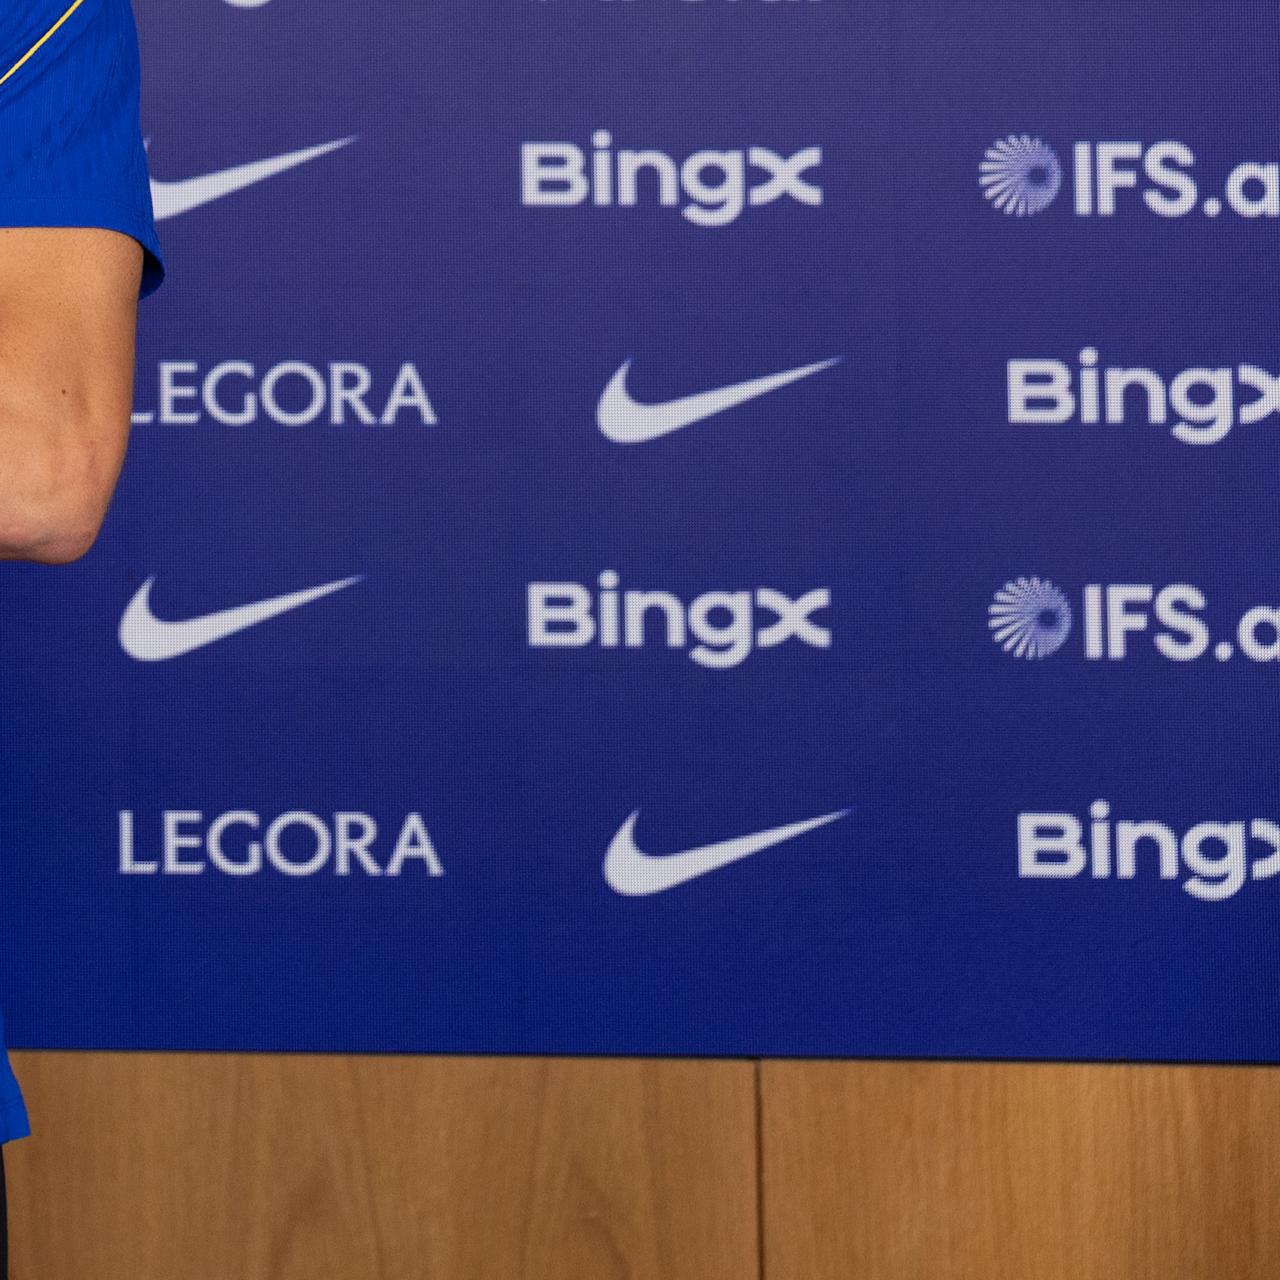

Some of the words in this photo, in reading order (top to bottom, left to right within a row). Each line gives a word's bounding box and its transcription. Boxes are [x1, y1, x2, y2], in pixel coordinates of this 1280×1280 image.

[1073, 140, 1280, 218] IFS.a
[1083, 583, 1280, 663] IFS.a
[118, 809, 444, 877] LEGORA
